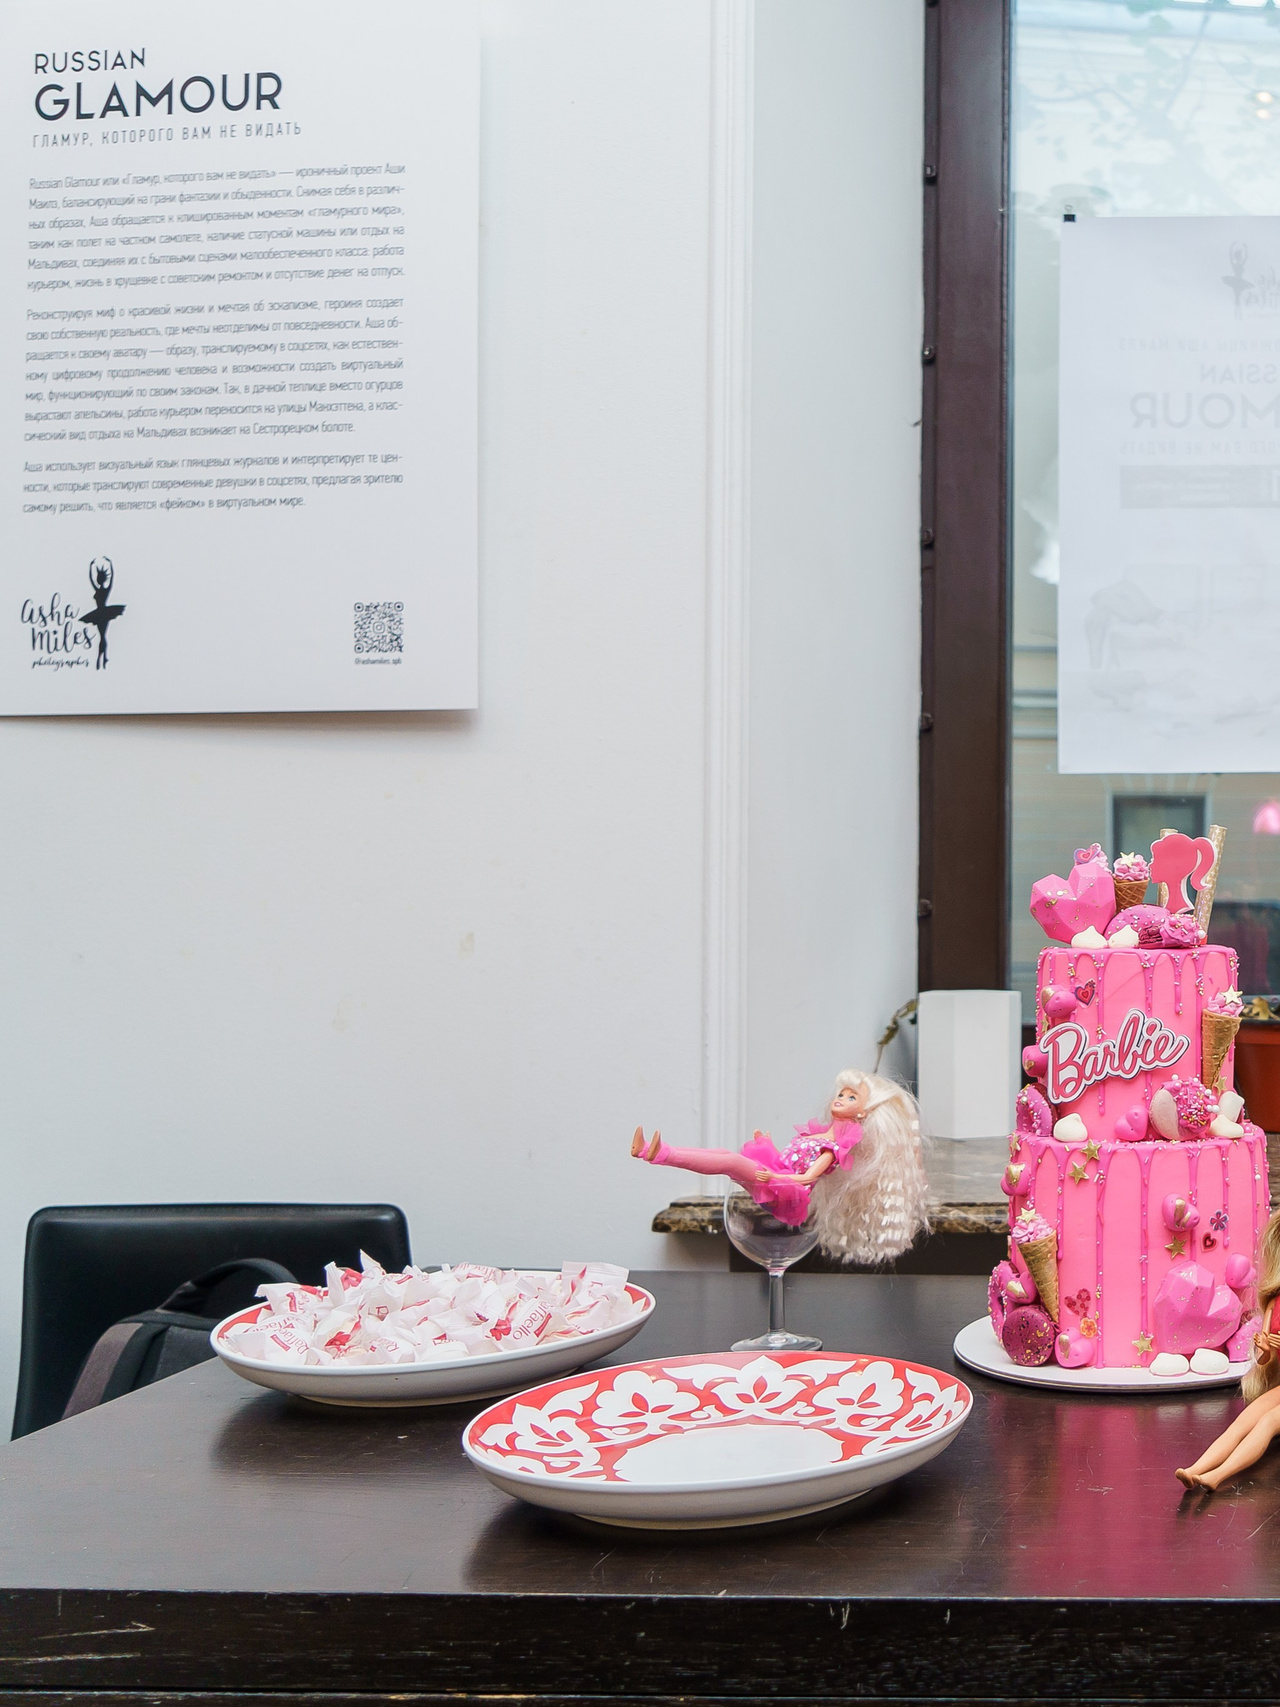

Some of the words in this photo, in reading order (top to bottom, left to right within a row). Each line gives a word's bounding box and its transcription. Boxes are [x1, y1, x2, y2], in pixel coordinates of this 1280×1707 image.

[34, 47, 146, 74] RUSSIAN
[34, 72, 283, 121] GLAMOUR
[32, 131, 94, 149] ГЛАМУР,
[101, 127, 174, 146] КОТОРОГО
[182, 125, 212, 141] ВАМ
[220, 123, 238, 139] НЕ
[246, 121, 302, 138] ВИДАТЬ
[1043, 1014, 1184, 1101] Barbie
